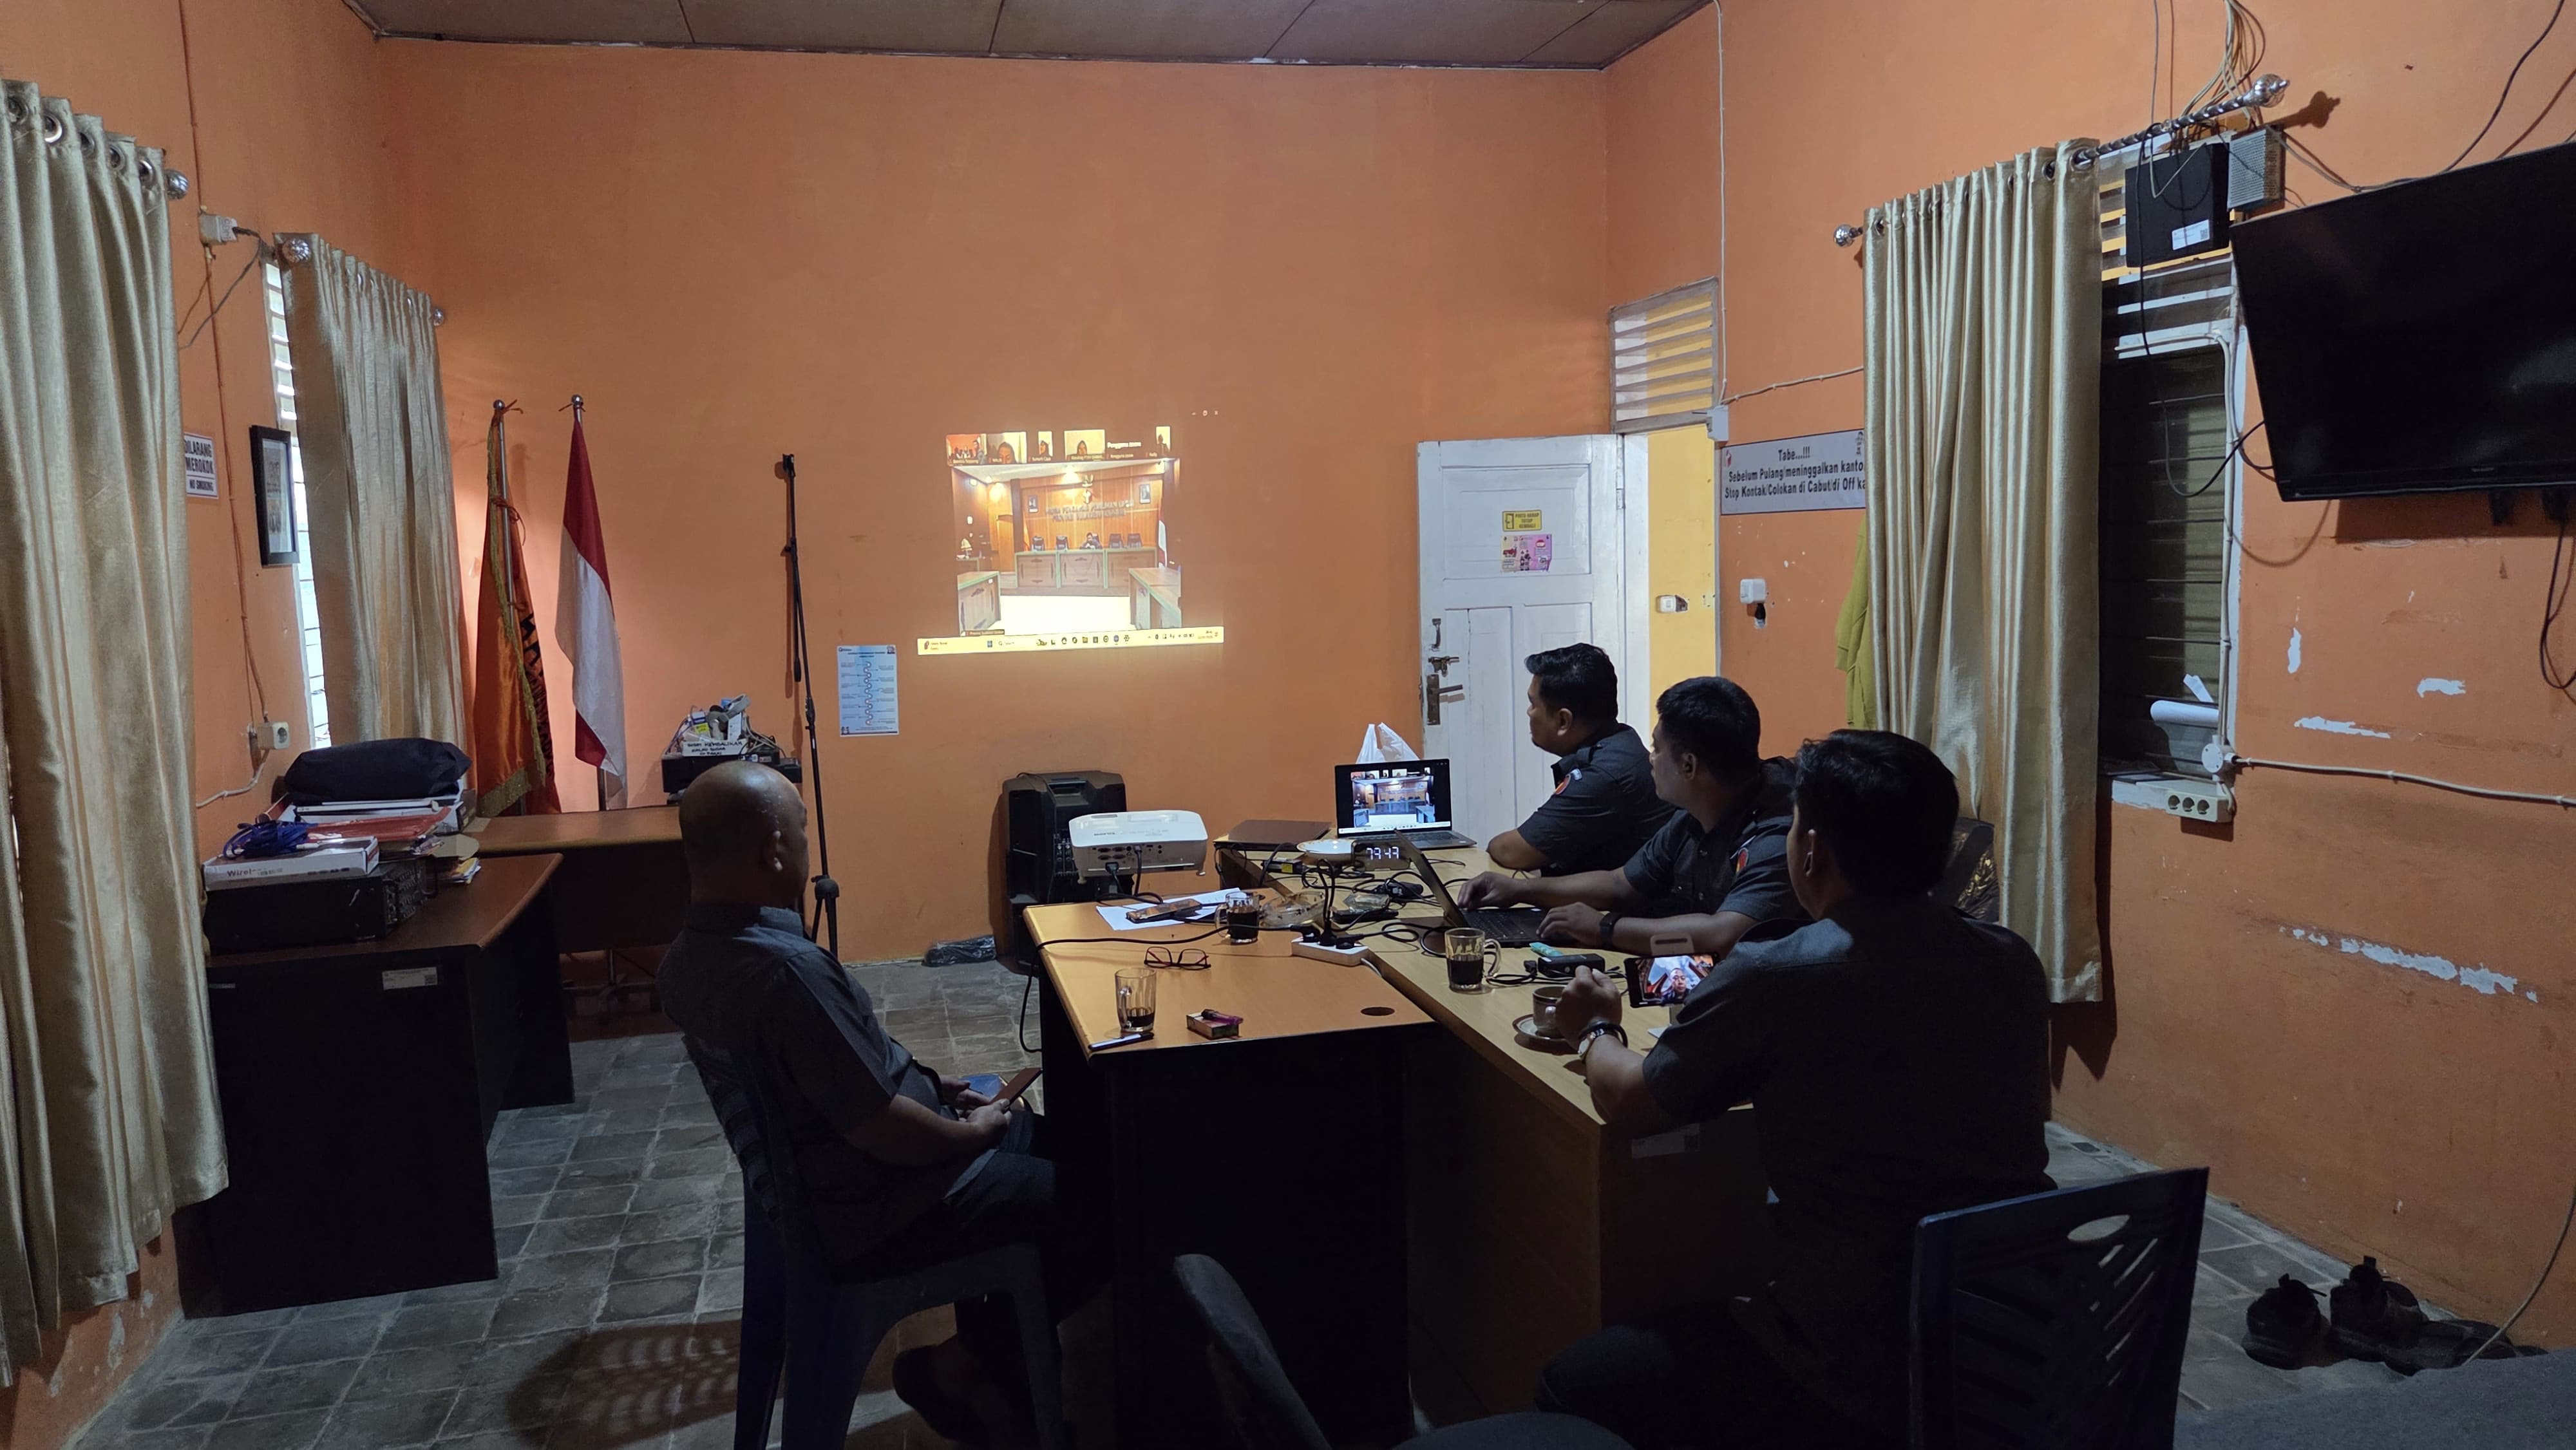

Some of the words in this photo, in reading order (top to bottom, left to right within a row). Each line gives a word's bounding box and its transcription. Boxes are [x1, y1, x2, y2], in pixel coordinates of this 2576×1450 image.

[1729, 471, 1757, 482] Sebelum
[1841, 460, 1864, 473] kanto
[189, 479, 195, 489] NO
[1725, 486, 1739, 501] Stop
[1799, 481, 1805, 493] di
[1842, 477, 1855, 491] Off
